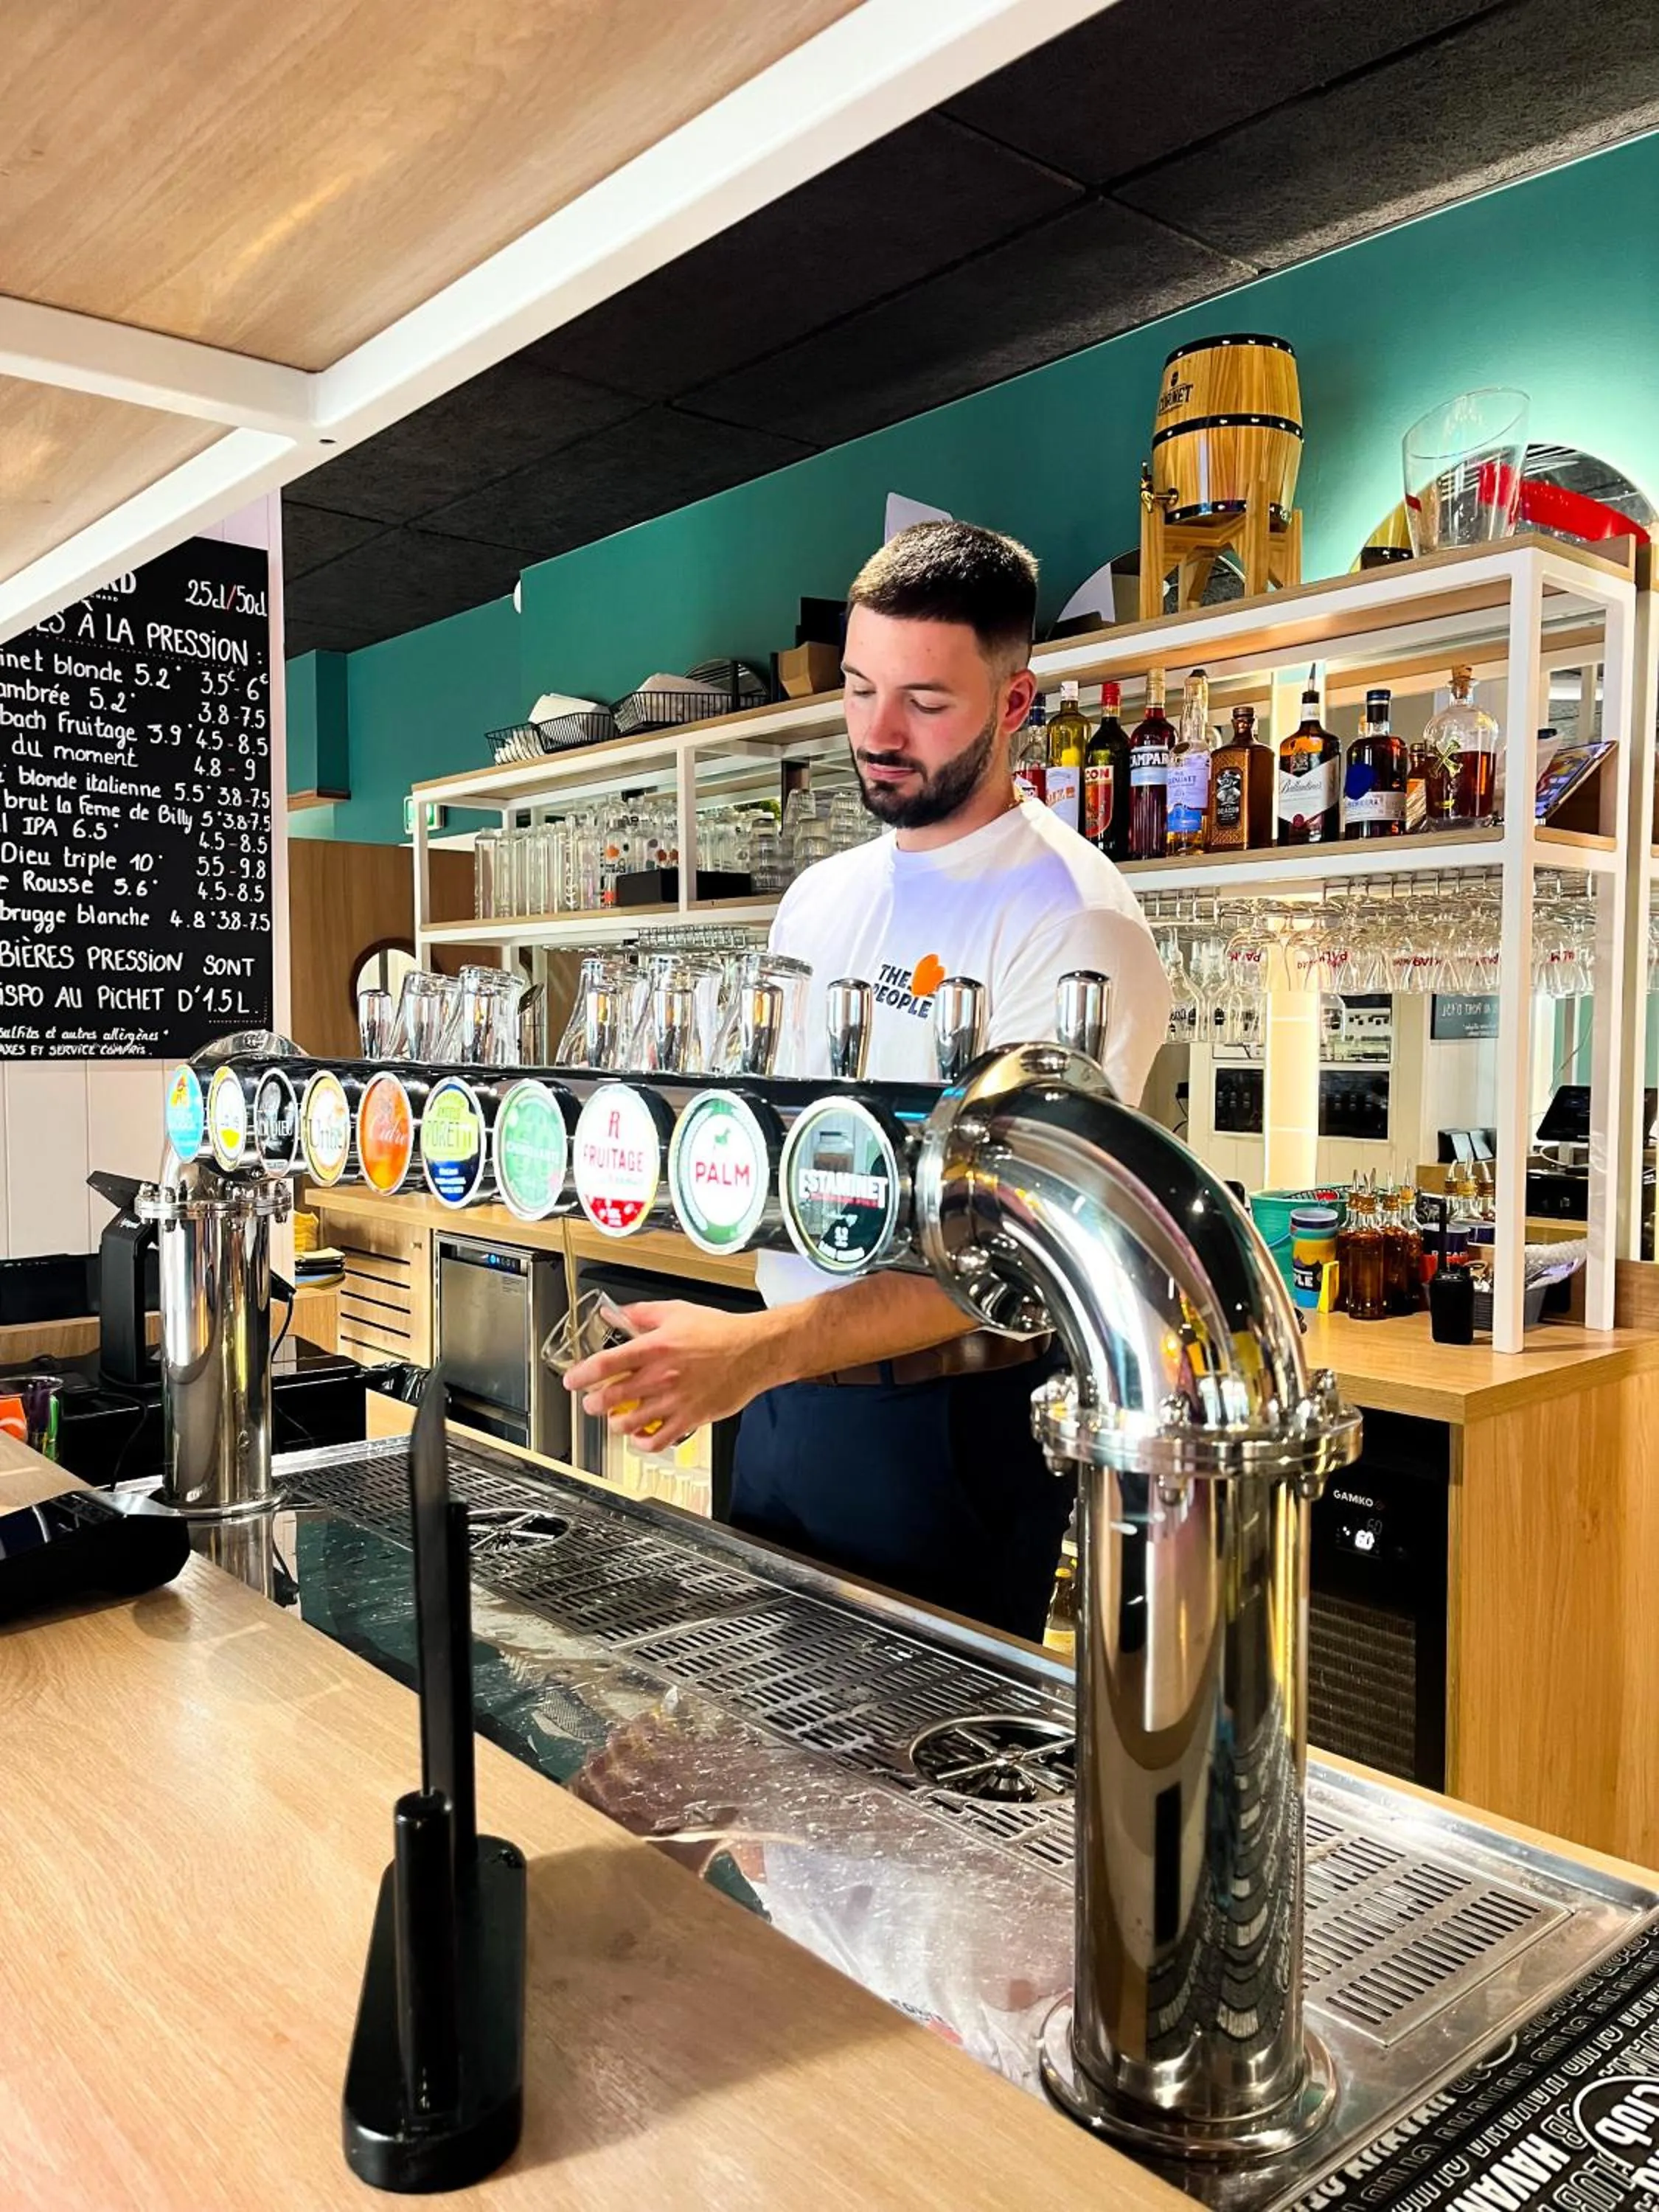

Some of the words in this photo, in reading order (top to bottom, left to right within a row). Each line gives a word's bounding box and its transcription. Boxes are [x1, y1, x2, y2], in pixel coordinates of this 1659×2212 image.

[106, 613, 135, 646] LA
[54, 653, 123, 683] blonde
[12, 733, 44, 757] du
[54, 745, 139, 768] moment
[18, 765, 77, 790] blonde
[86, 773, 161, 799] italienne
[4, 788, 49, 812] brut
[57, 794, 72, 814] la
[129, 802, 149, 820] de
[158, 804, 192, 834] Billy
[22, 816, 58, 837] IPA
[1, 841, 51, 866] Dieu
[63, 846, 117, 876] triple
[23, 869, 94, 894] Rousse
[77, 902, 150, 926] blanche
[203, 955, 255, 976] SONT
[879, 964, 912, 989] THE
[54, 987, 83, 1009] AU
[874, 982, 933, 1019] PEOPLE
[583, 1143, 644, 1173] FRUITAGE
[695, 1161, 751, 1187] PALM
[1333, 1489, 1374, 1507] GAMKO
